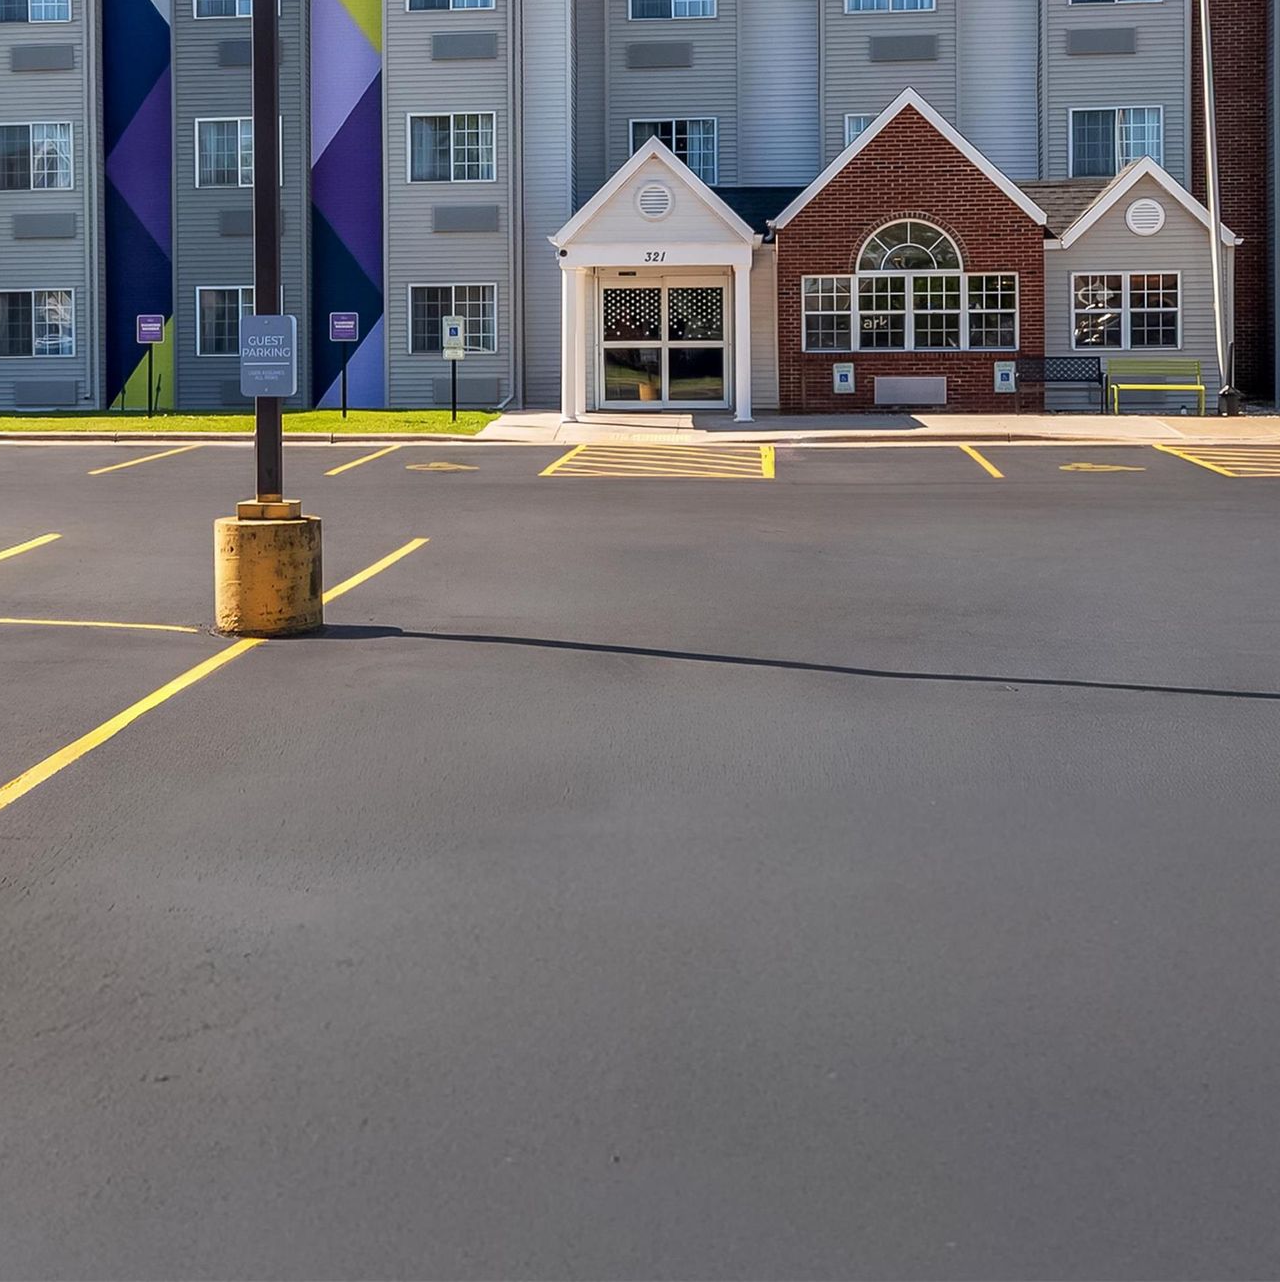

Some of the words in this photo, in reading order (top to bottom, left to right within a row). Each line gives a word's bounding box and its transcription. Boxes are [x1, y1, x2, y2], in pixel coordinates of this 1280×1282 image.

[644, 251, 666, 262] 321
[248, 335, 285, 346] GUEST
[242, 347, 291, 358] PARKING
